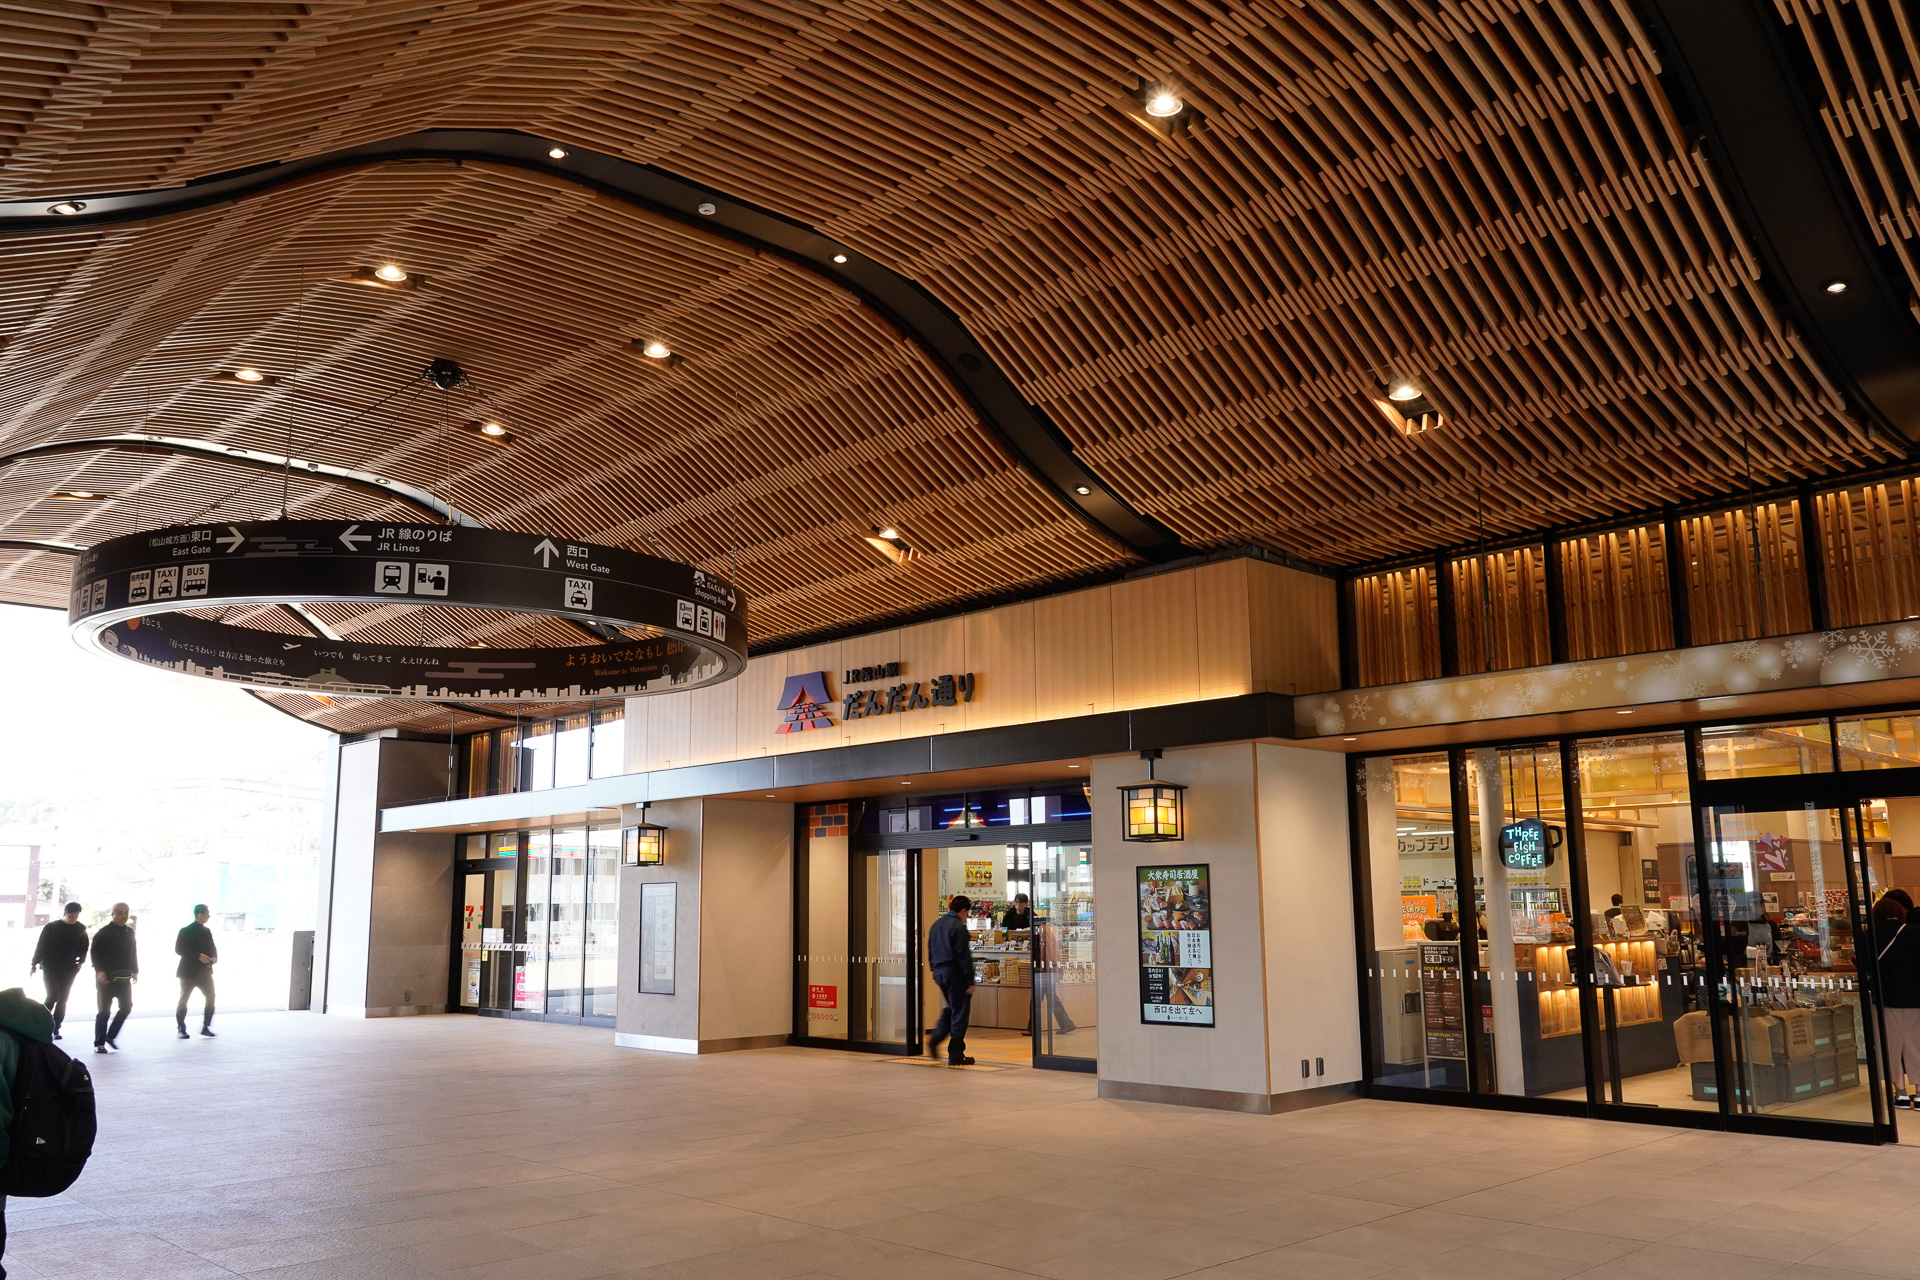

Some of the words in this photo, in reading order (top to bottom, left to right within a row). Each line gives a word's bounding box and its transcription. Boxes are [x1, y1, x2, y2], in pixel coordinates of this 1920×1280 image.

[172, 547, 189, 556] East
[191, 545, 211, 554] Gate
[377, 542, 391, 551] JR
[393, 543, 420, 553] Lines
[566, 544, 589, 558] 西口
[187, 566, 205, 576] BUS
[566, 559, 589, 571] West
[590, 564, 611, 574] Gate
[157, 568, 177, 579] TAXI
[567, 579, 591, 591] TAXI
[594, 667, 620, 677] Welcome
[842, 672, 976, 721] だんだん通り
[1505, 826, 1540, 842] THREE
[1513, 841, 1536, 854] FISH
[1508, 853, 1542, 867] COFFEE
[1147, 868, 1199, 881] 大衆寿司居酒屋
[1154, 1005, 1203, 1015] 西口を出て左へ
